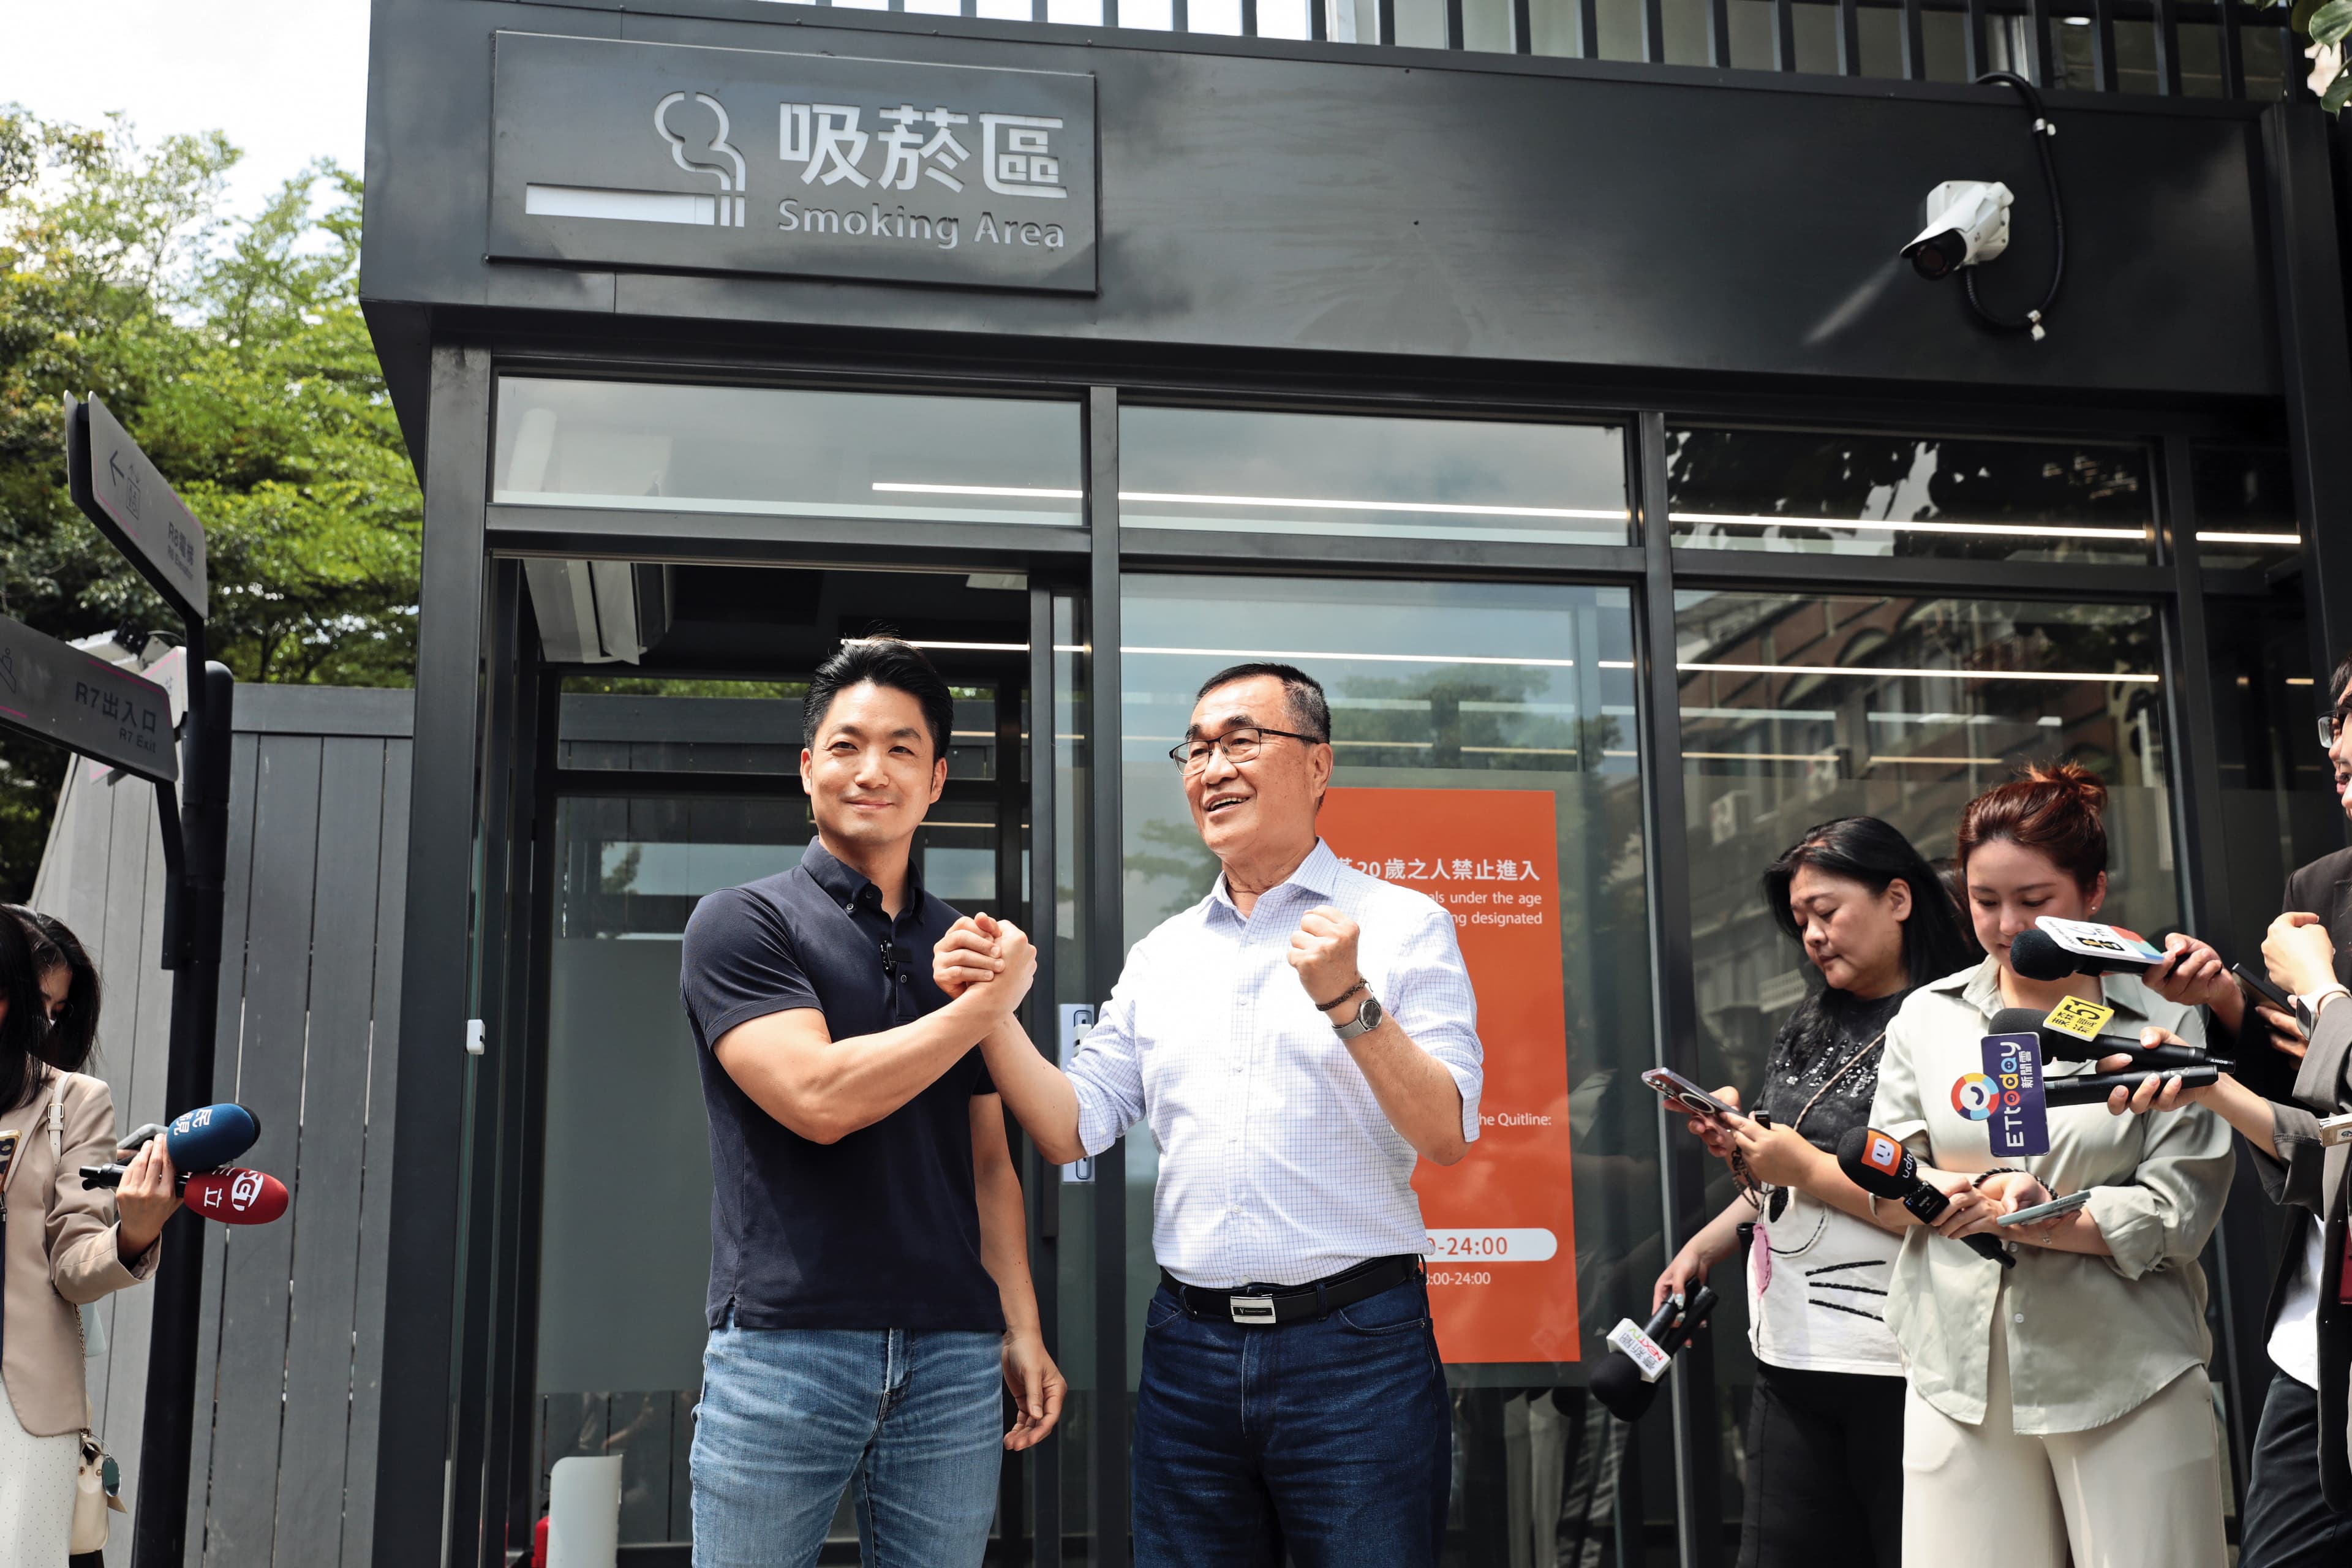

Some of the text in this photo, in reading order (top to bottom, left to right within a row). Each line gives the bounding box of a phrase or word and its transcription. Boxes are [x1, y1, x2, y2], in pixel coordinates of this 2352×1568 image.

[779, 102, 1068, 198] 吸菸區
[778, 199, 1065, 249] Smoking Area
[75, 681, 157, 734] R7出入口
[119, 727, 157, 753] R7 Exit
[1450, 891, 1488, 904] under
[1492, 891, 1513, 904] the
[1518, 894, 1542, 907] age
[1471, 911, 1542, 927] designated
[2064, 999, 2106, 1020] 51
[2018, 1050, 2034, 1088] 新聞雲
[1999, 1041, 2025, 1147] ETtoday
[1478, 1112, 1552, 1127] he Quitline:
[1902, 1153, 1913, 1179] udn
